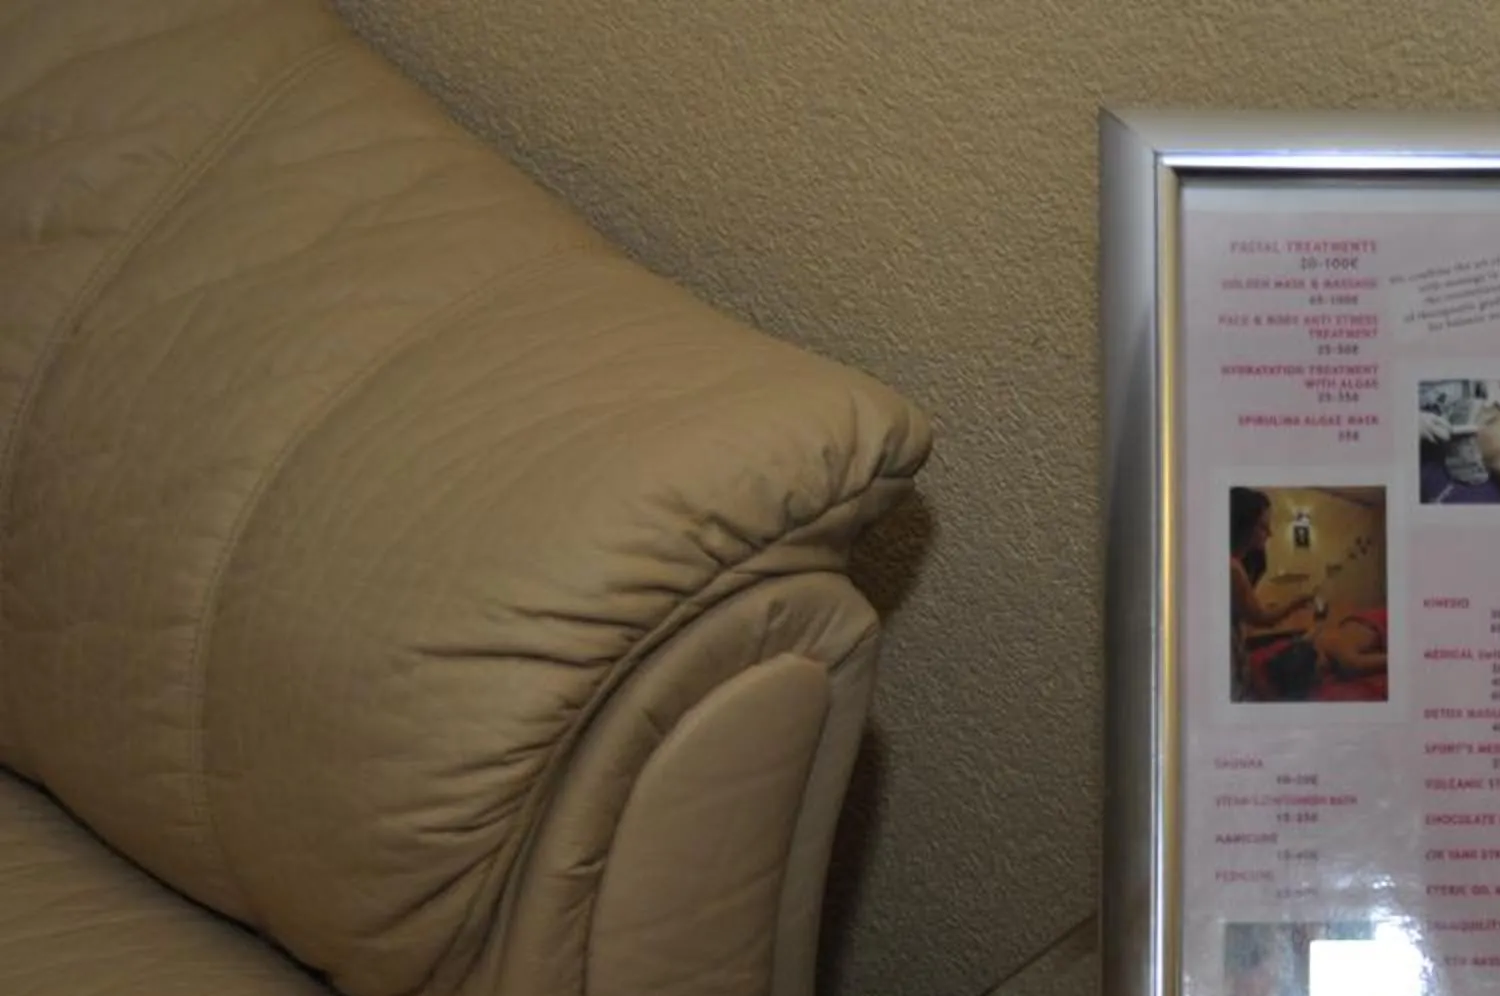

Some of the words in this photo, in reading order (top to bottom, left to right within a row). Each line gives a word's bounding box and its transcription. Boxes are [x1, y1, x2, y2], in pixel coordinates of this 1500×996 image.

[1286, 240, 1377, 253] TREATMENTS
[1308, 328, 1378, 339] TREATMENT
[1308, 364, 1378, 375] TREATMENT
[1425, 814, 1495, 826] CHOCOLATE
